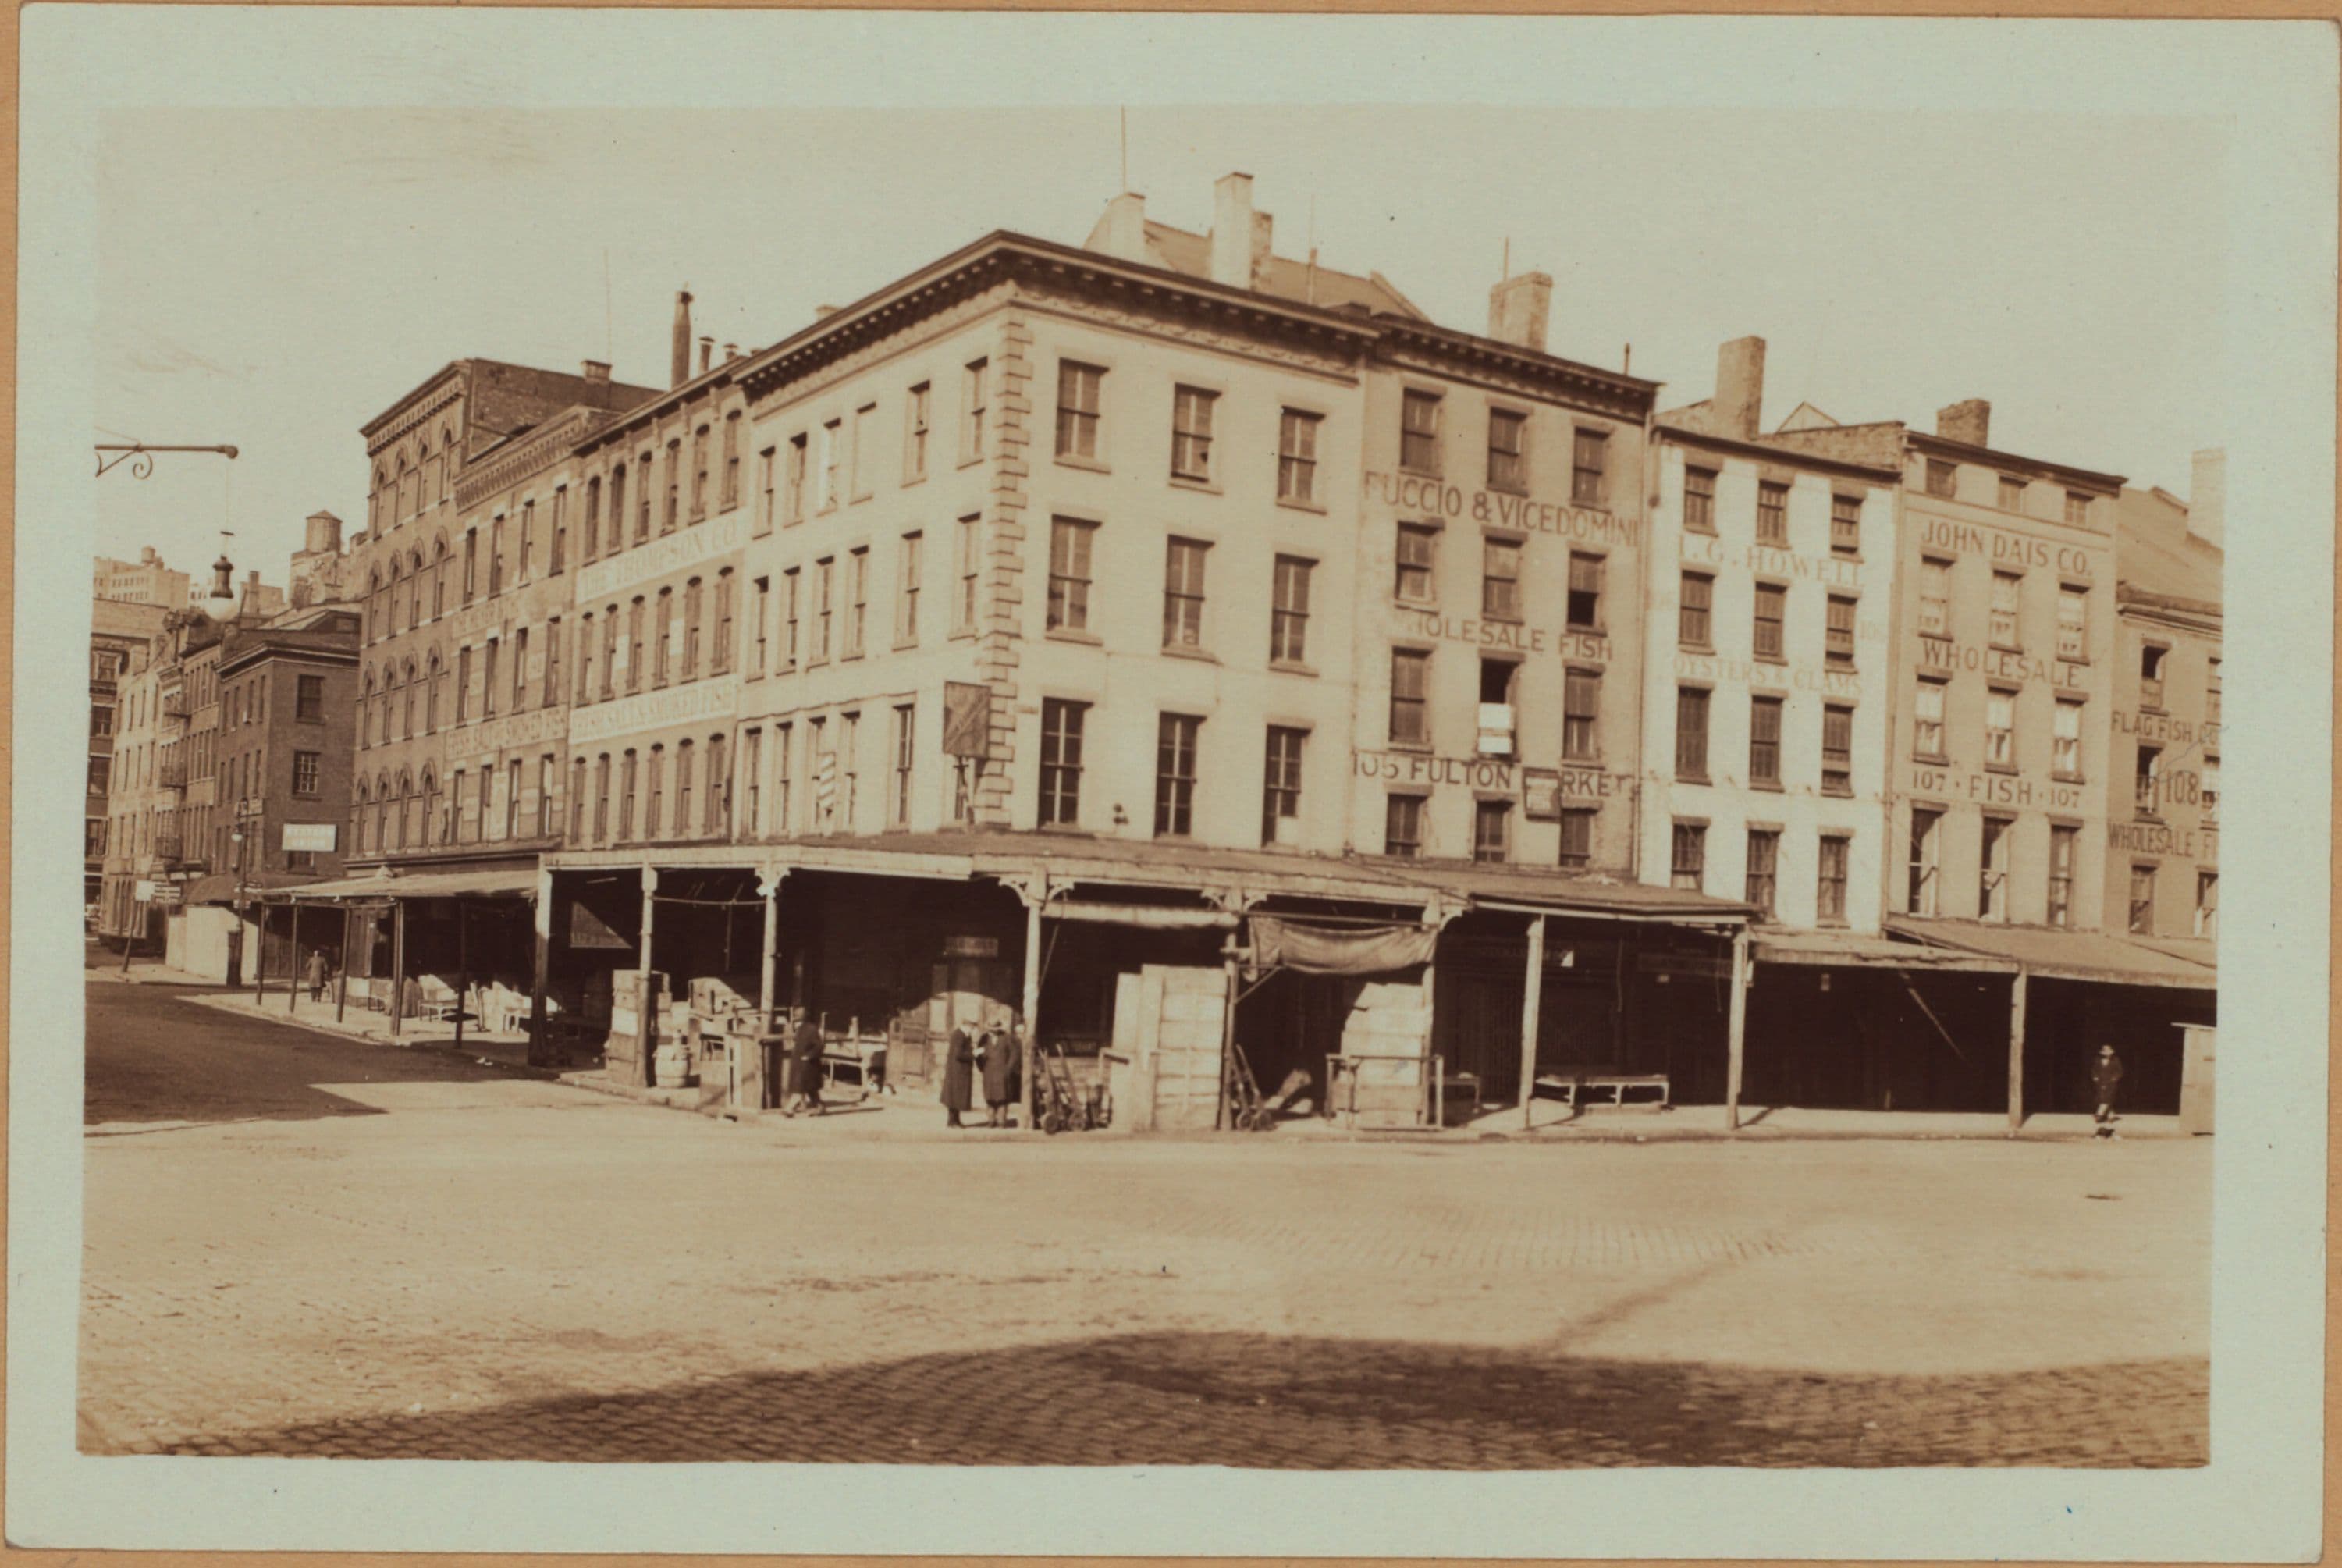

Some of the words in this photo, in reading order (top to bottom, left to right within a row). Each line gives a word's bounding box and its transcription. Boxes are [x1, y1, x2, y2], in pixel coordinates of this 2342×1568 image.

[1473, 492, 1491, 521] &
[1921, 521, 1984, 553] JOHN
[1992, 535, 2049, 568] DAIS
[1559, 634, 1612, 663] FISH
[1924, 639, 2081, 688] WHOLESALE
[2111, 710, 2152, 736] FLAG
[2158, 718, 2192, 742] FISH
[1410, 757, 1512, 788] FULTON
[1561, 770, 1634, 798] RKET
[1913, 770, 1946, 792] 107
[1969, 774, 2032, 806] FISH
[2050, 787, 2081, 809] 107
[2165, 769, 2199, 806] 108
